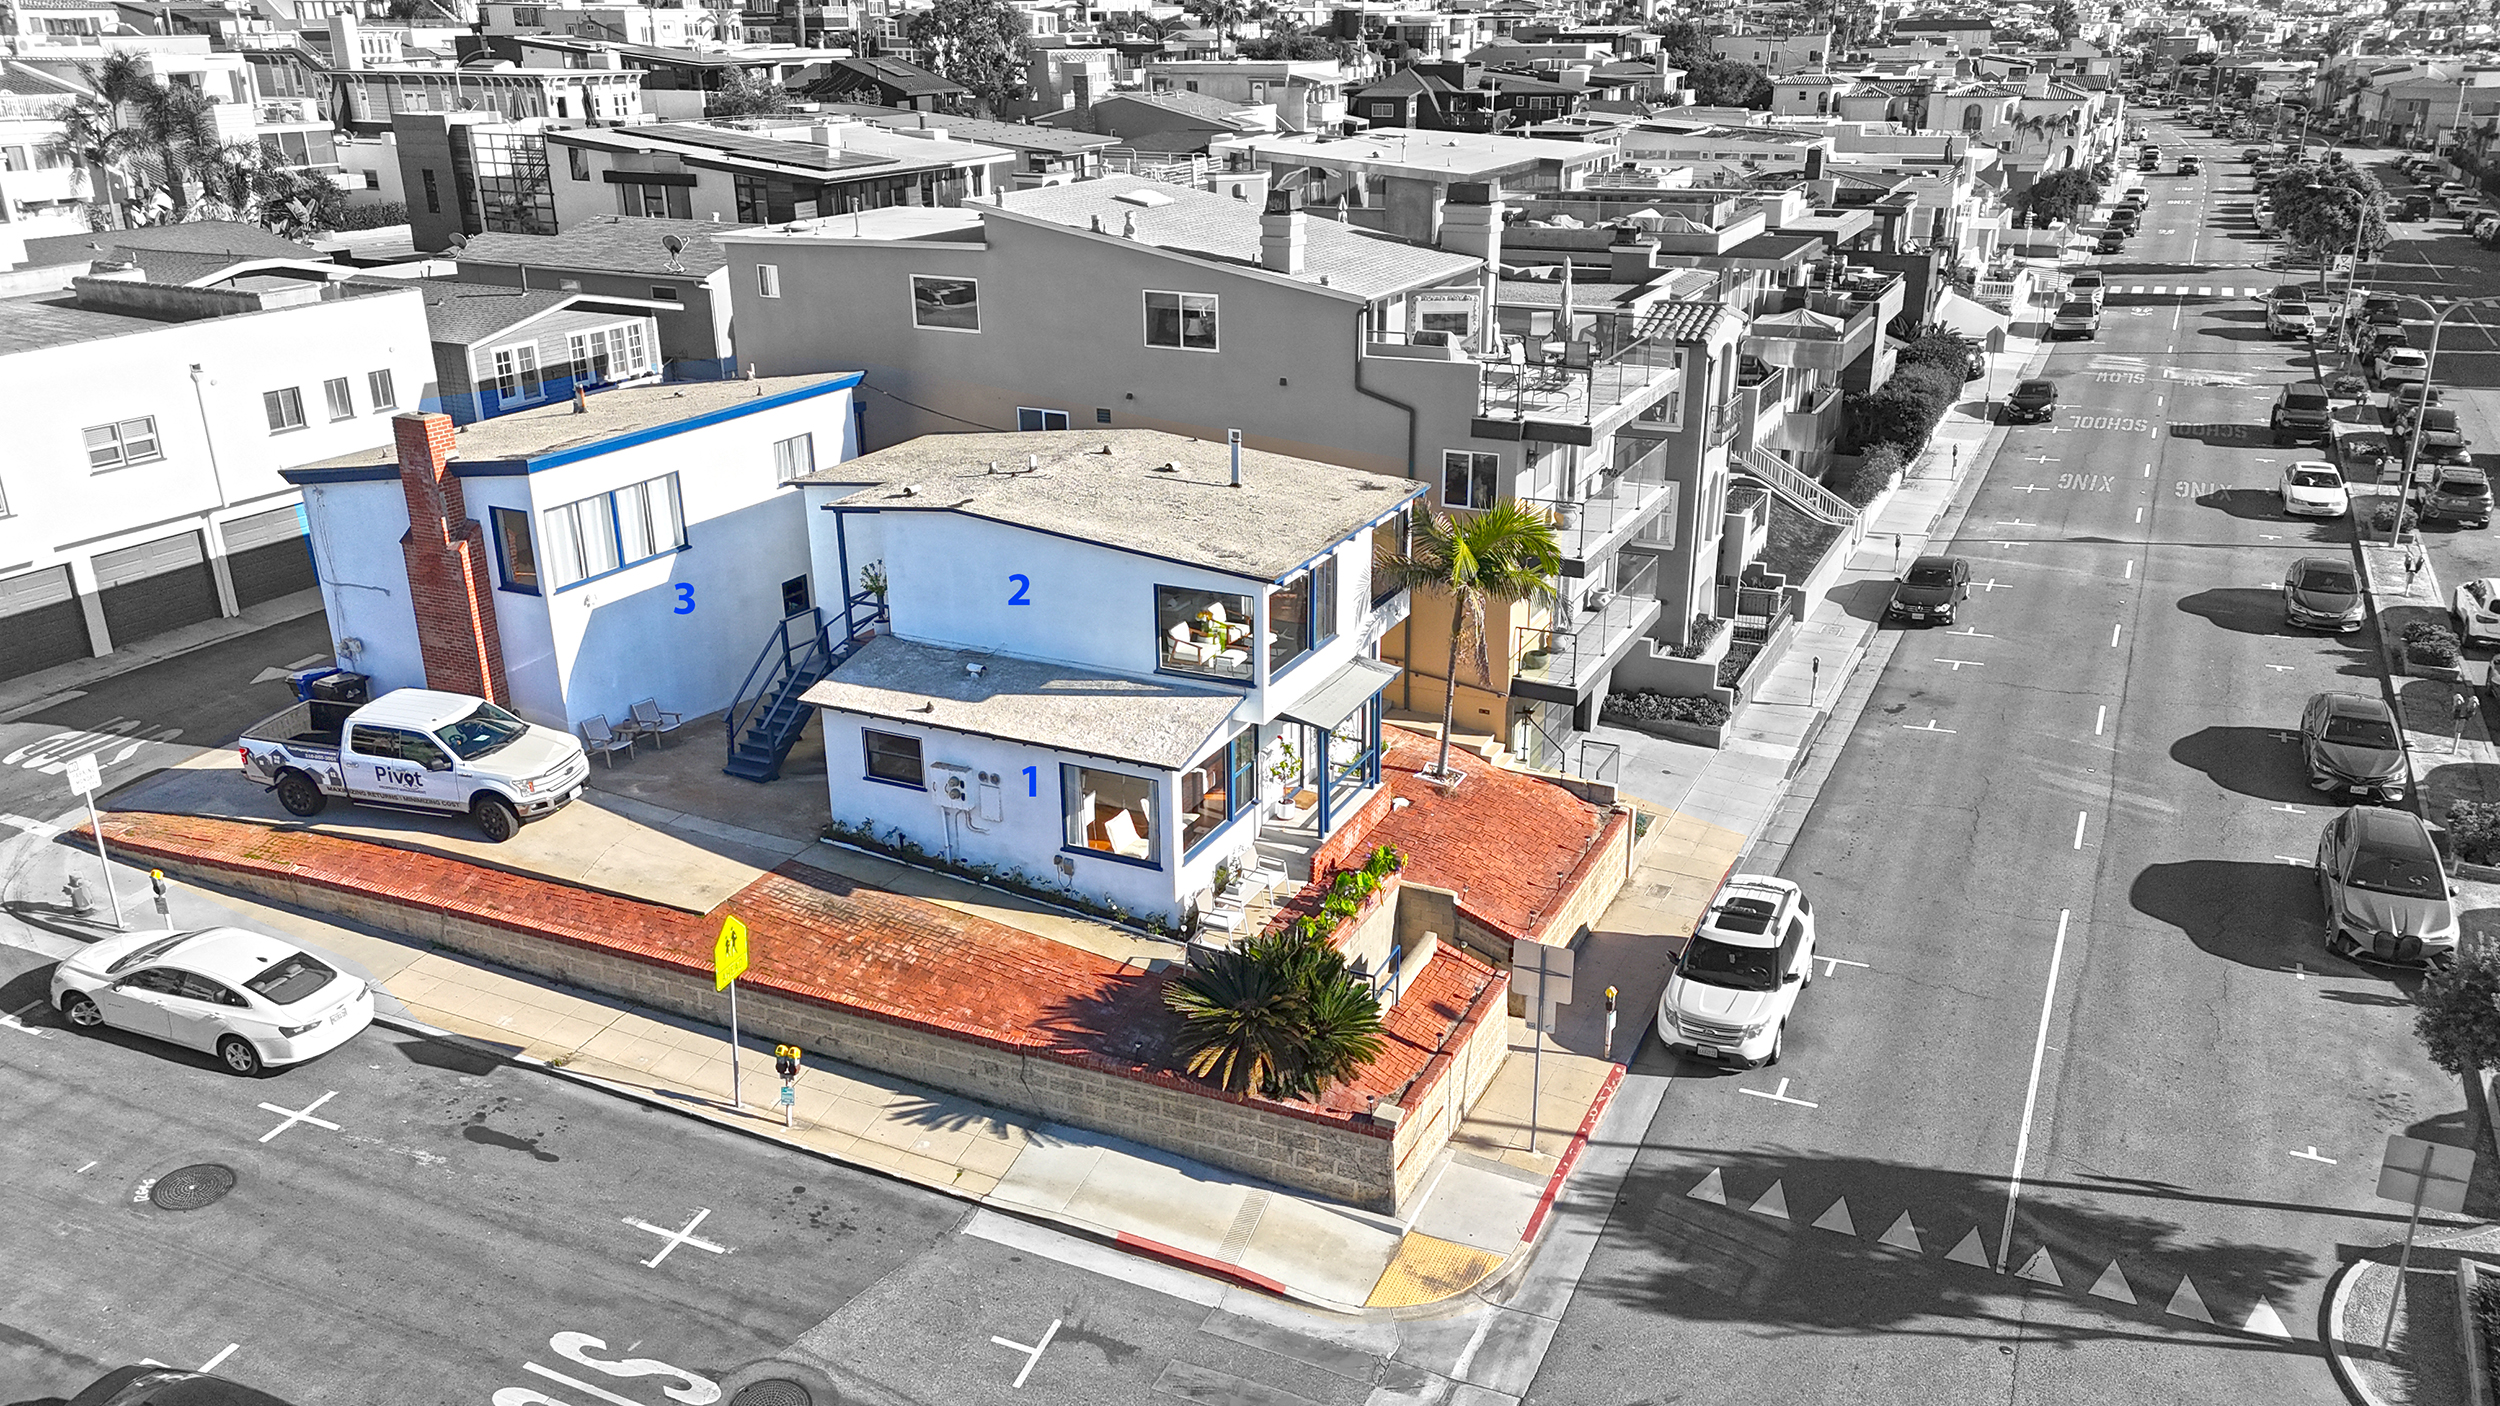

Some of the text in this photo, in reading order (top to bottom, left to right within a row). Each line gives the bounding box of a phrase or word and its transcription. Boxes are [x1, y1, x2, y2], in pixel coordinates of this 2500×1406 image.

[2095, 372, 2146, 384] SLOW
[2069, 415, 2148, 432] SCHOOL
[2166, 421, 2248, 438] SCHOOL
[2057, 472, 2115, 493] XING
[2175, 480, 2232, 502] XING
[375, 765, 424, 788] Pivot
[367, 791, 399, 801] RETURNS
[402, 796, 441, 806] MINIMIZING
[722, 958, 743, 982] AHEAD
